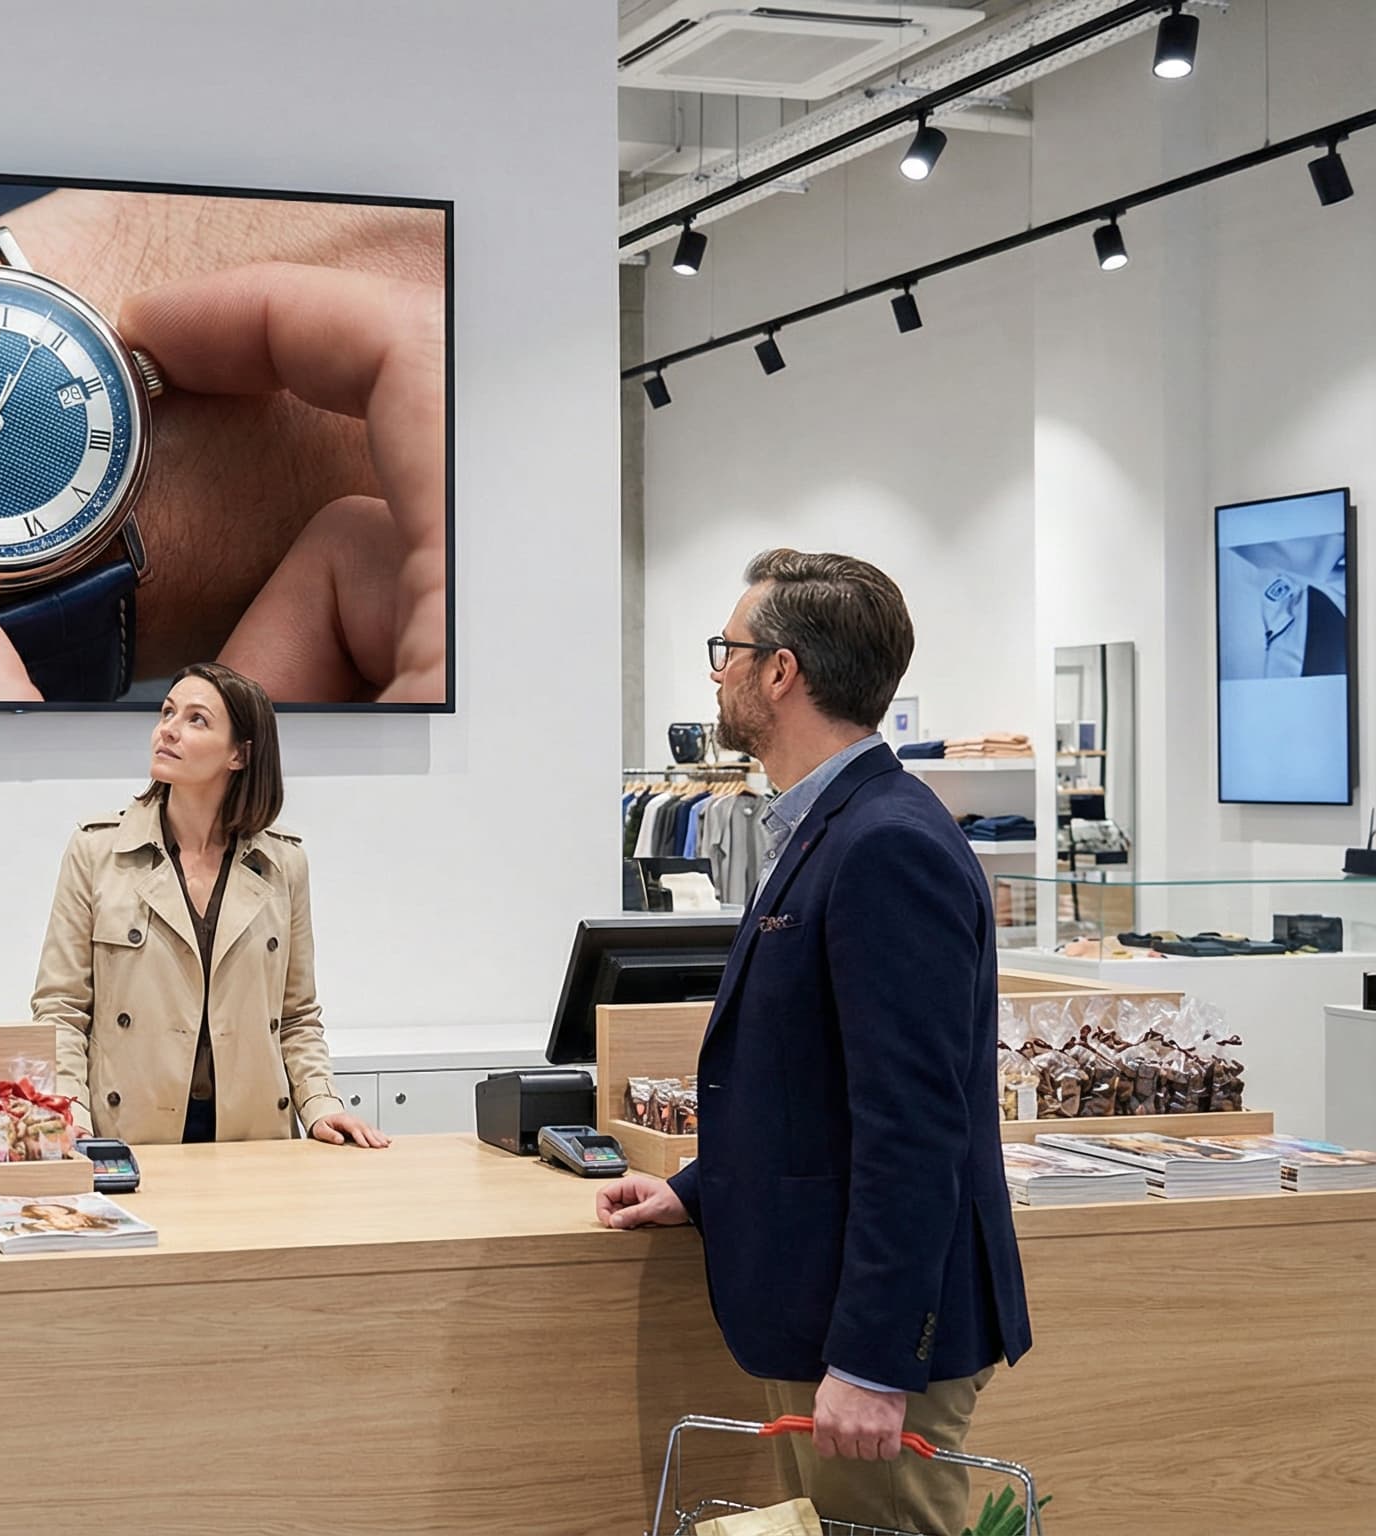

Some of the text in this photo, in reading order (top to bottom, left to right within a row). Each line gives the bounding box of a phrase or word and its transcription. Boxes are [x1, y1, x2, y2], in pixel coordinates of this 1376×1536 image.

[50, 331, 68, 351] II
[83, 376, 104, 394] III
[88, 429, 112, 452] IIII
[71, 485, 91, 503] V
[22, 515, 48, 538] VI
